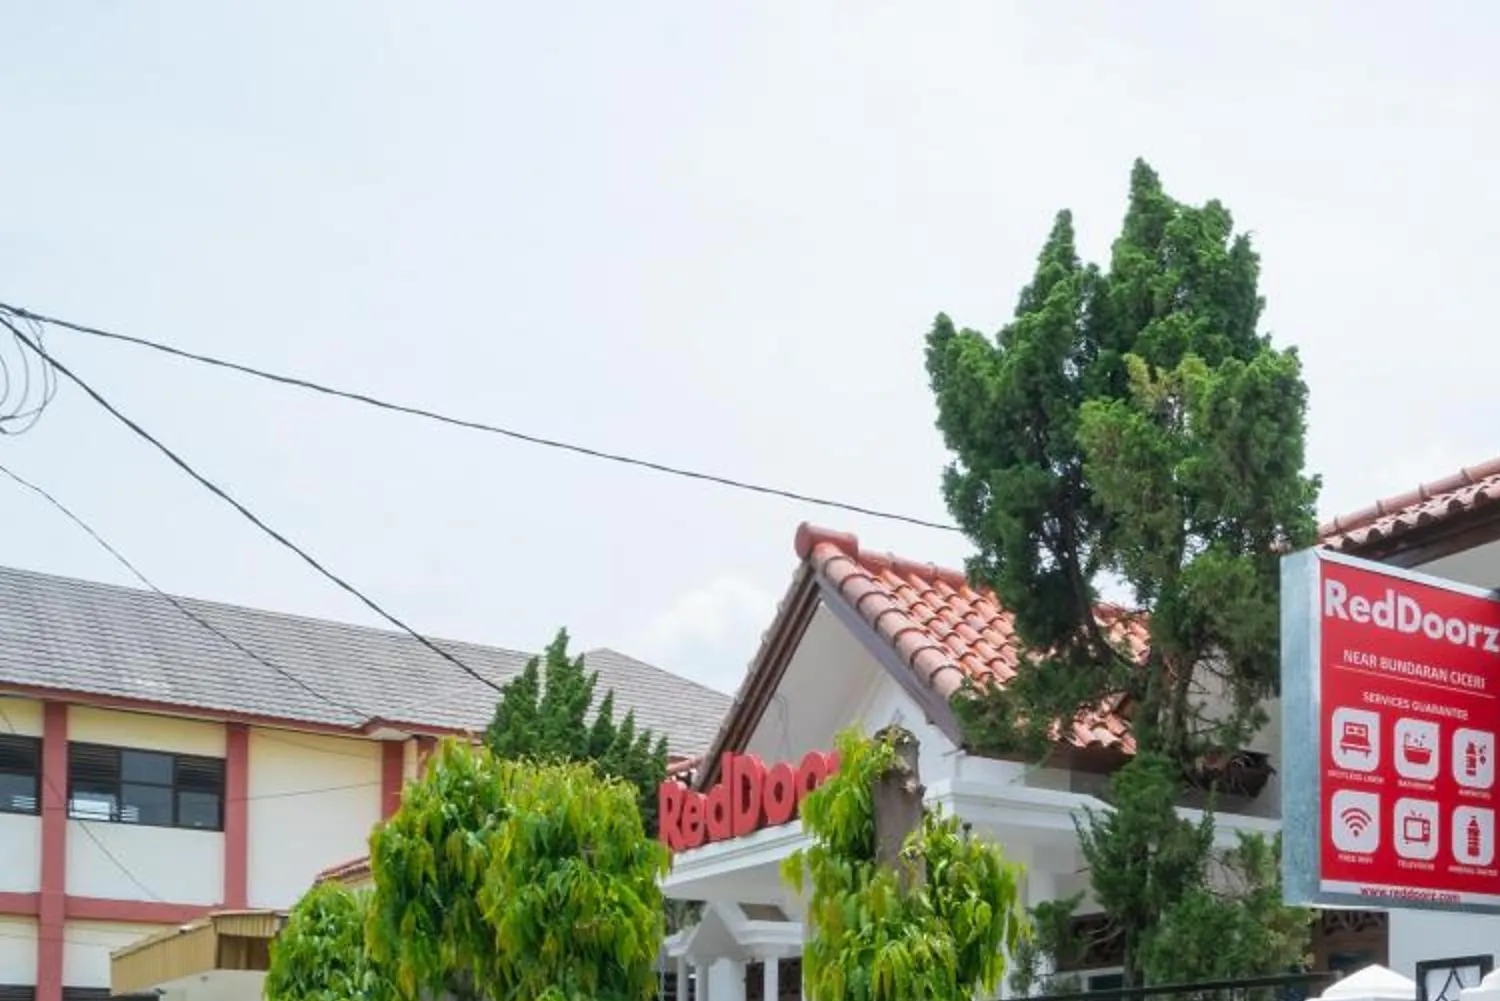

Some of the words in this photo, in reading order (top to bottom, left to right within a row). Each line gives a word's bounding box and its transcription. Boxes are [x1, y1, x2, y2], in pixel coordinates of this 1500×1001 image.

[1324, 579, 1500, 653] RedDoorz
[1343, 650, 1377, 668] NEAR
[1380, 656, 1447, 683] BUNDARAN
[1450, 670, 1485, 689] CICERI
[1362, 691, 1410, 711] SERVICES
[1412, 700, 1469, 721] GUARANTEE
